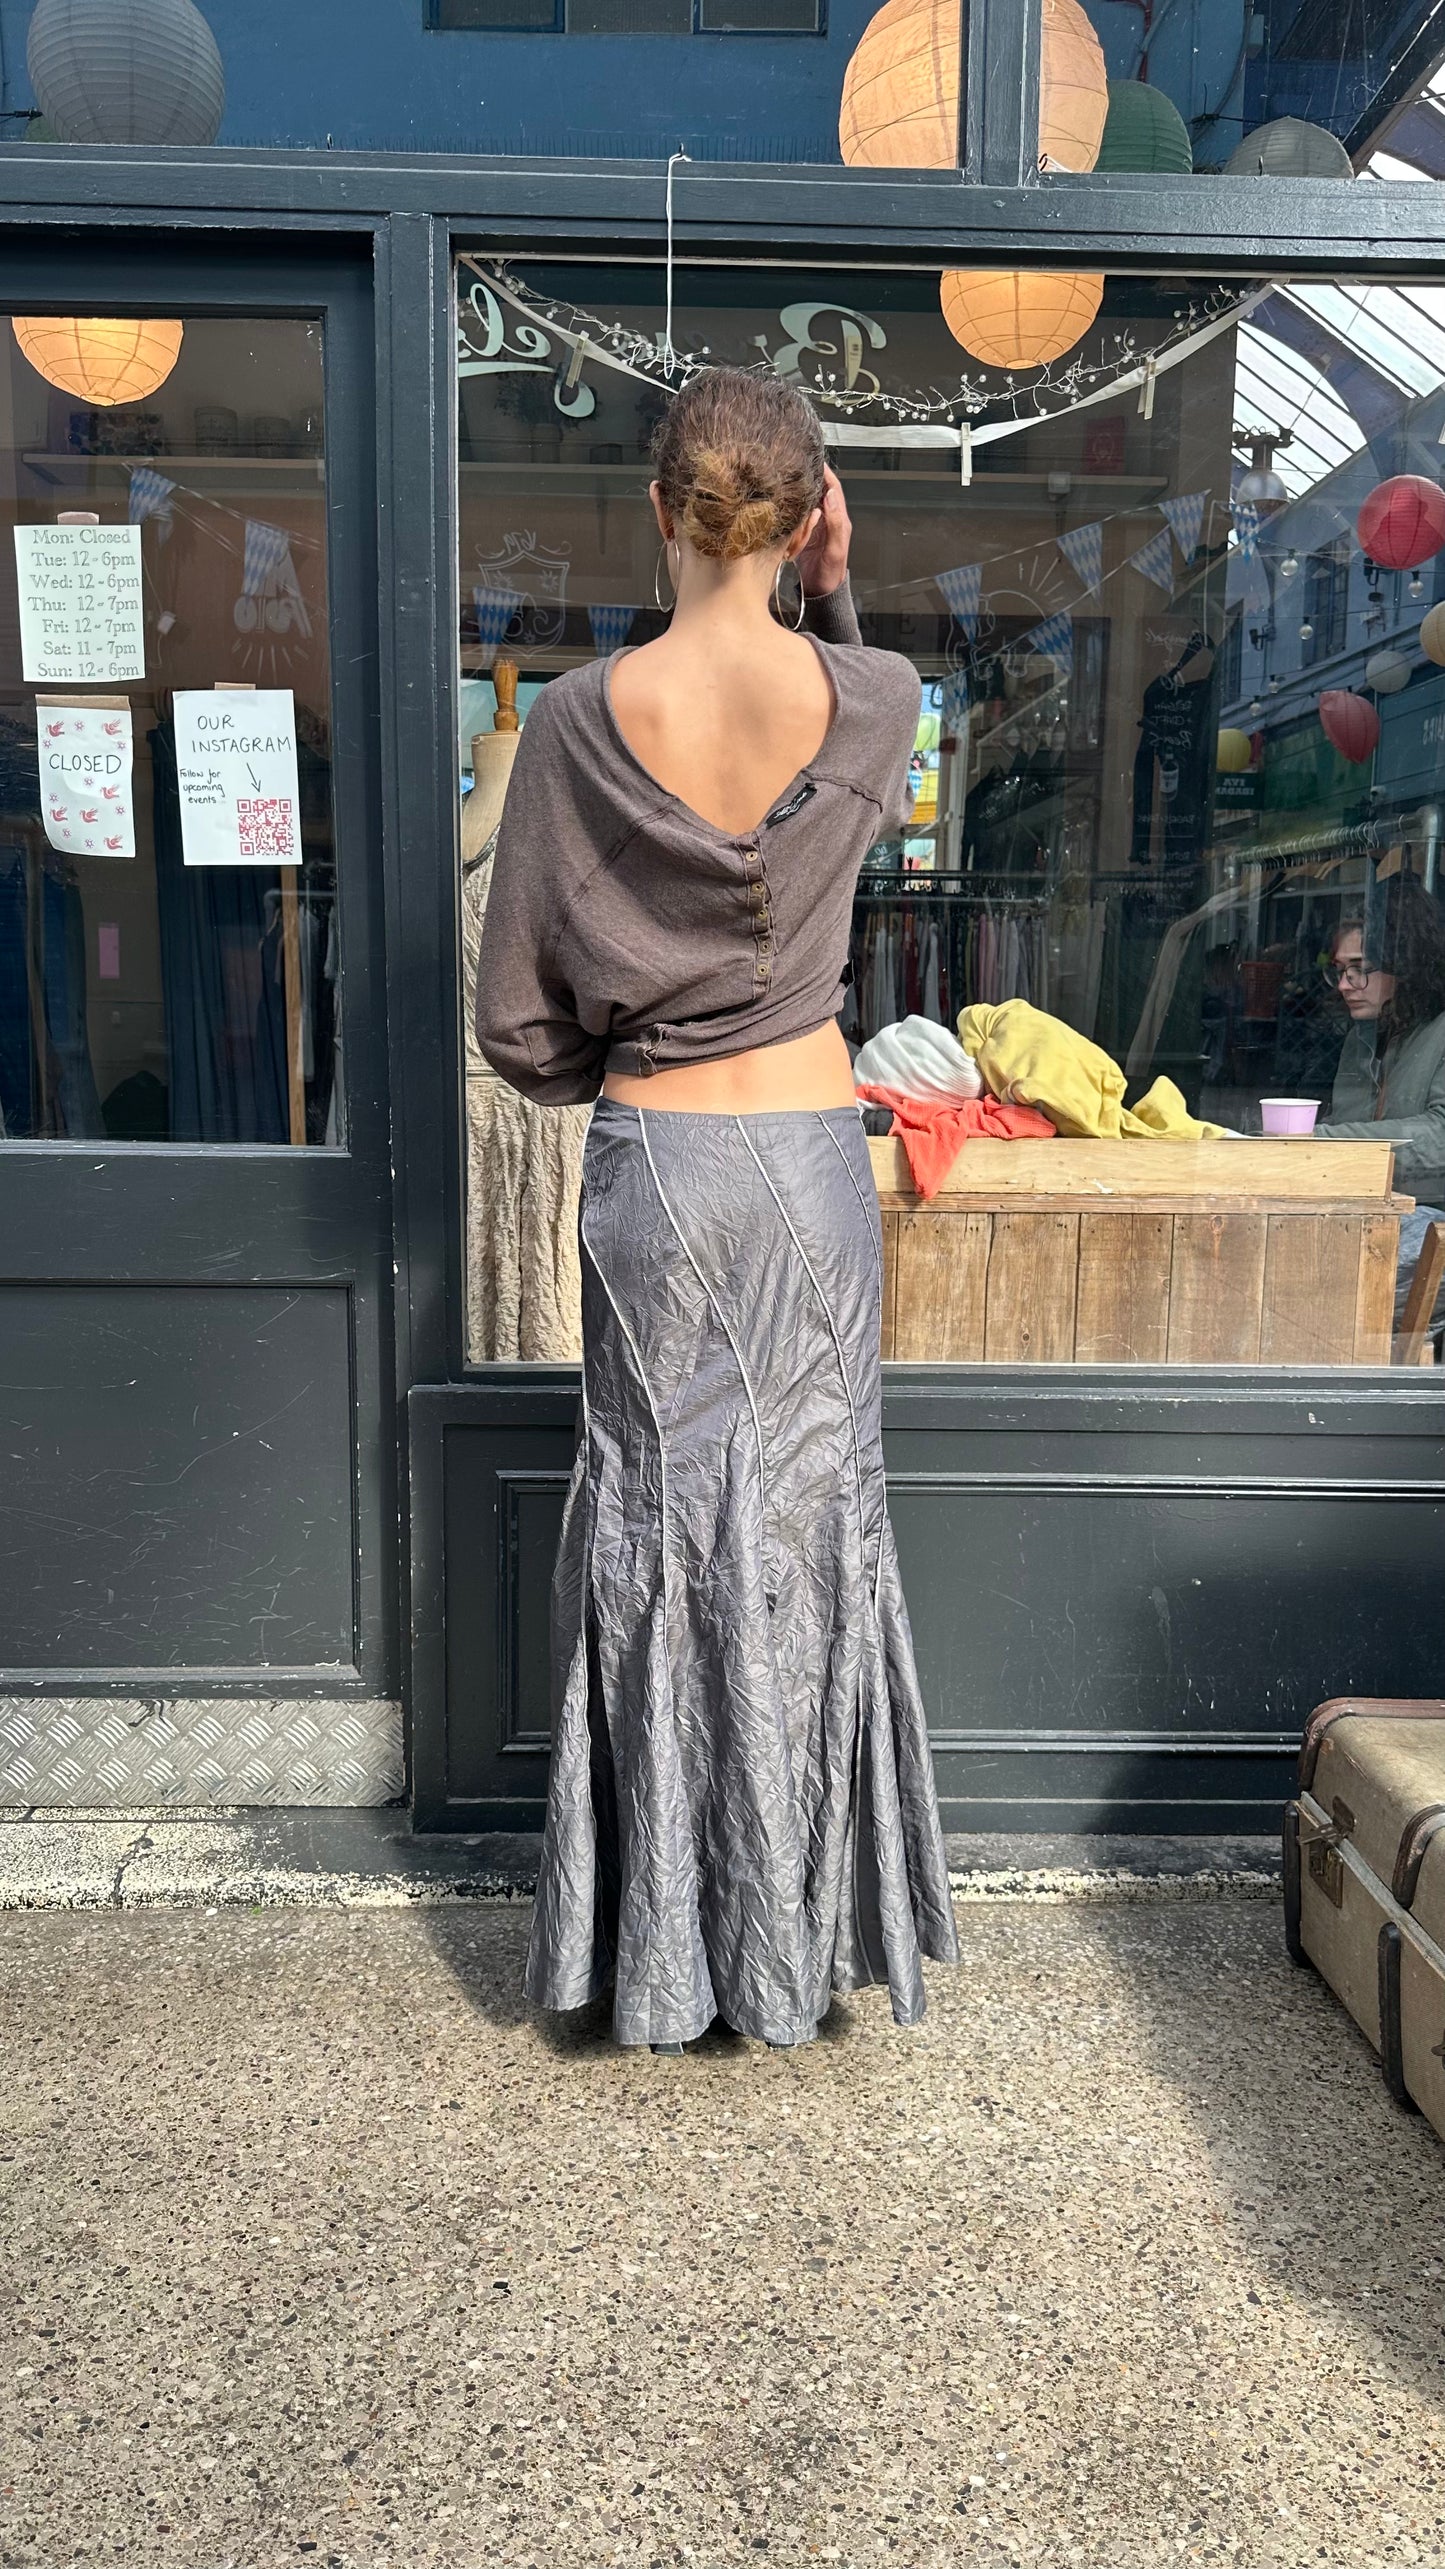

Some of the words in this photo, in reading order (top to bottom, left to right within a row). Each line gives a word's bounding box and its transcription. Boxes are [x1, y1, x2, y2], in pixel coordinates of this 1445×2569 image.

[33, 529, 74, 544] Mon:
[79, 529, 131, 544] Closed
[31, 552, 67, 566] Tue:
[72, 551, 90, 566] 12
[101, 551, 136, 570] 6pm
[29, 574, 73, 589] Wed:
[78, 573, 95, 589] 12
[107, 573, 141, 592] 6pm
[27, 596, 66, 611] Thu:
[77, 595, 95, 611] 12
[107, 595, 139, 615] 7pm
[42, 618, 69, 633] Fri:
[75, 617, 92, 633] 12
[104, 619, 136, 637] 7pm
[43, 641, 72, 655] Sat:
[77, 641, 91, 655] 11
[106, 641, 137, 659] 7pm
[37, 662, 73, 677] Sun:
[78, 662, 96, 677] 12
[108, 662, 140, 680] 6pm
[197, 714, 235, 730] OUR
[191, 736, 292, 753] INSTAGRAM
[48, 753, 122, 774] CLOSED
[179, 768, 204, 778] Follow
[207, 768, 221, 785] for
[182, 783, 226, 798] upcoming
[187, 796, 217, 804] events
